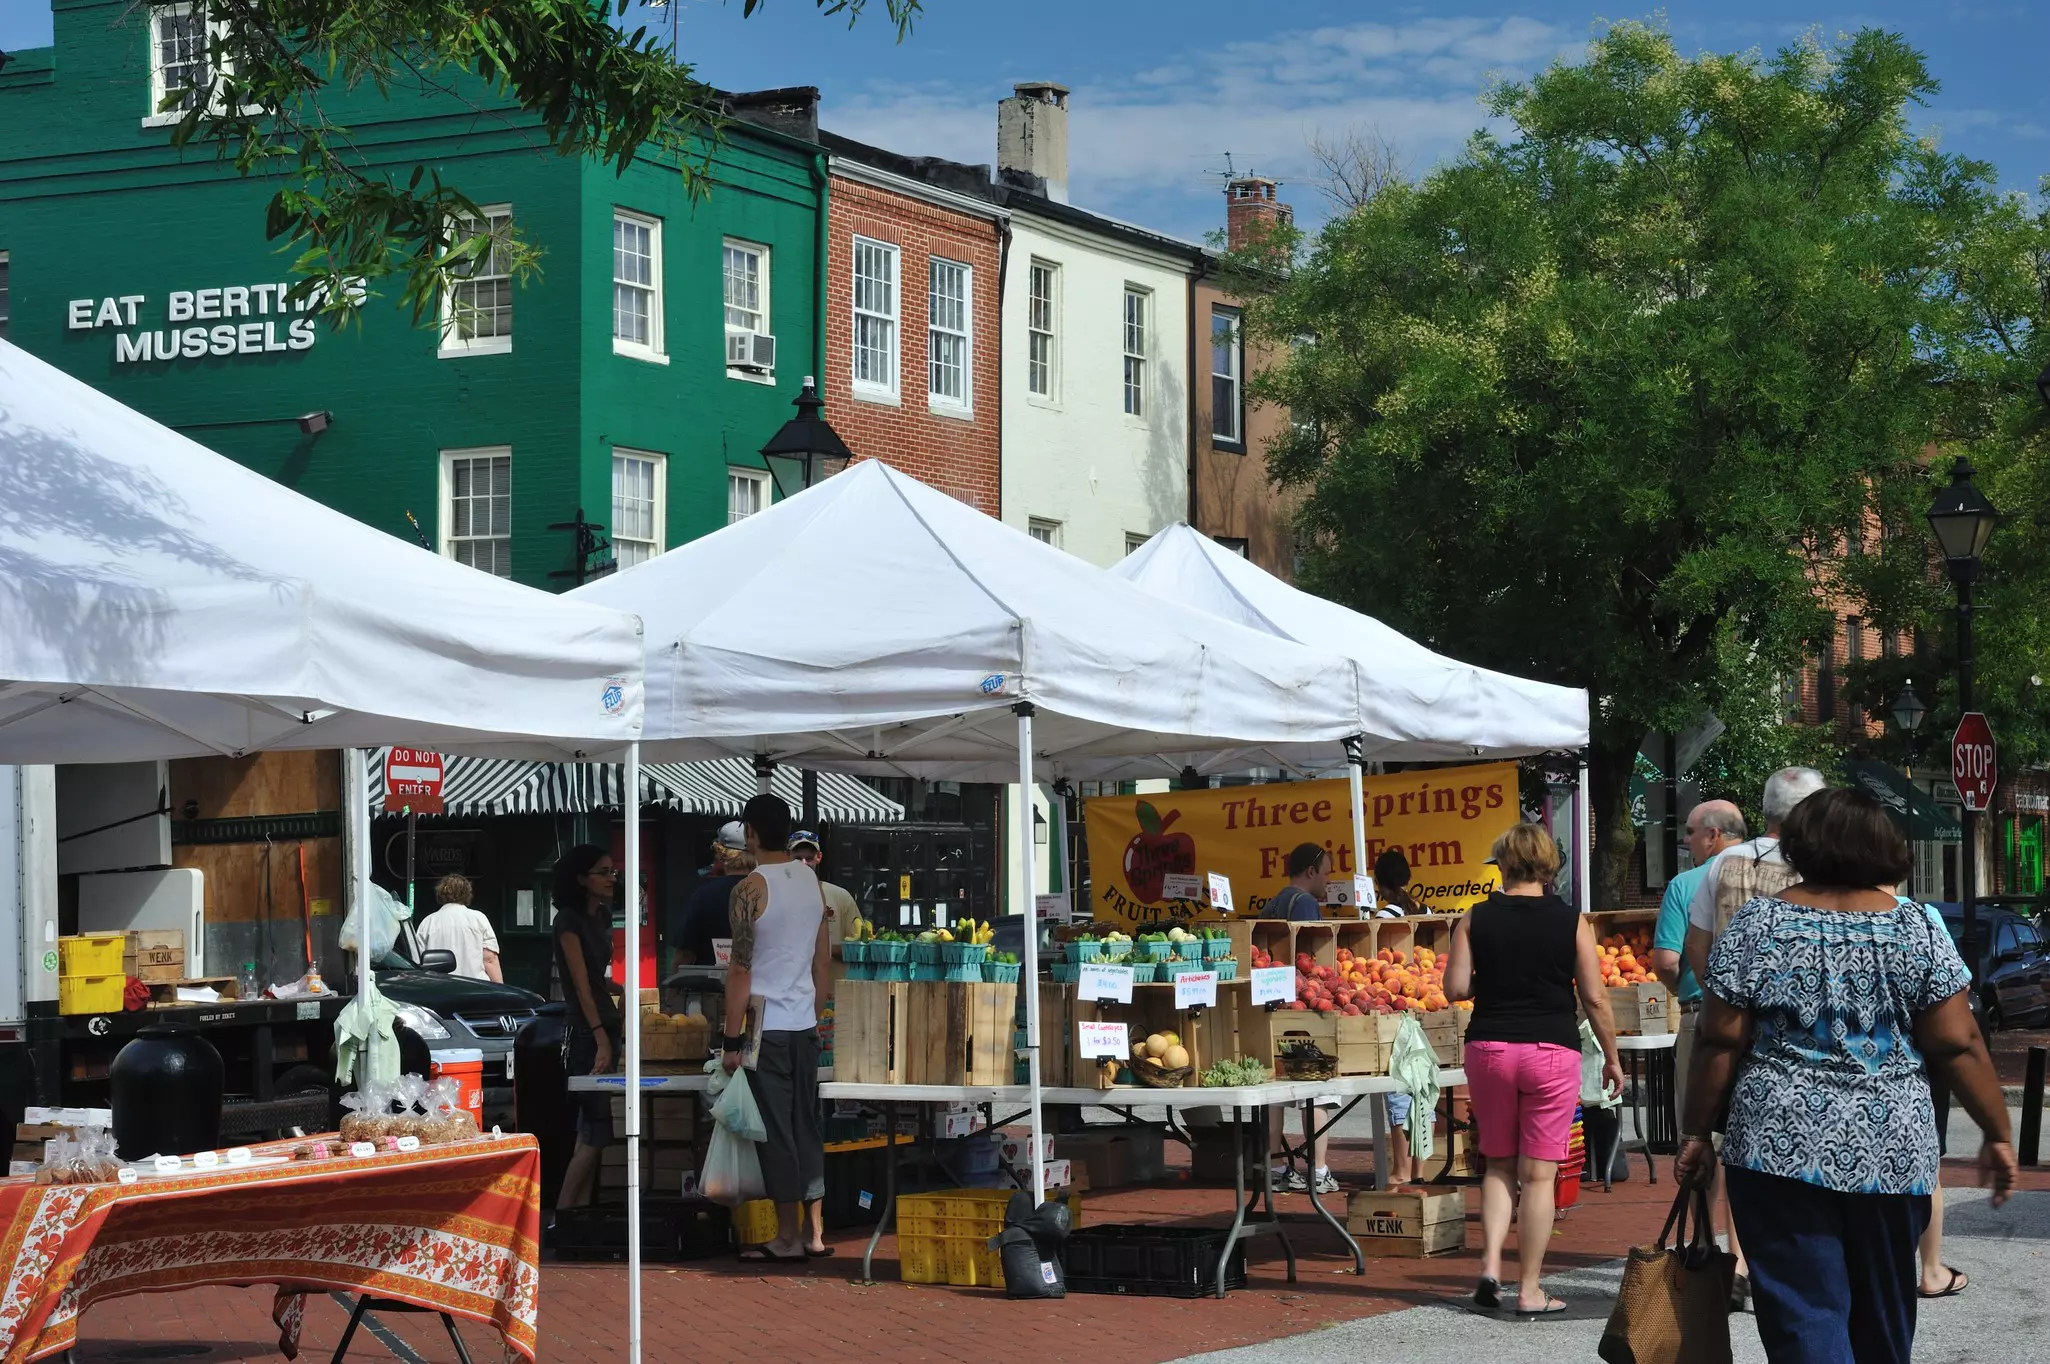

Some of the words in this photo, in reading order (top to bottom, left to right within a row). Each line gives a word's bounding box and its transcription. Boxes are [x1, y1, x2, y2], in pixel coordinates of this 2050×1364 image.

[69, 295, 145, 329] EAT
[116, 319, 316, 363] MUSSELS
[395, 749, 410, 763] DO
[415, 751, 436, 764] NOT
[1956, 743, 1993, 779] STOP
[398, 784, 431, 796] ENTER
[1222, 797, 1332, 830] Three
[1259, 839, 1351, 878] Frit
[1102, 884, 1162, 925] FRUIT
[1409, 878, 1496, 902] Operated
[150, 951, 173, 964] WENK
[1366, 1218, 1404, 1234] WENK
